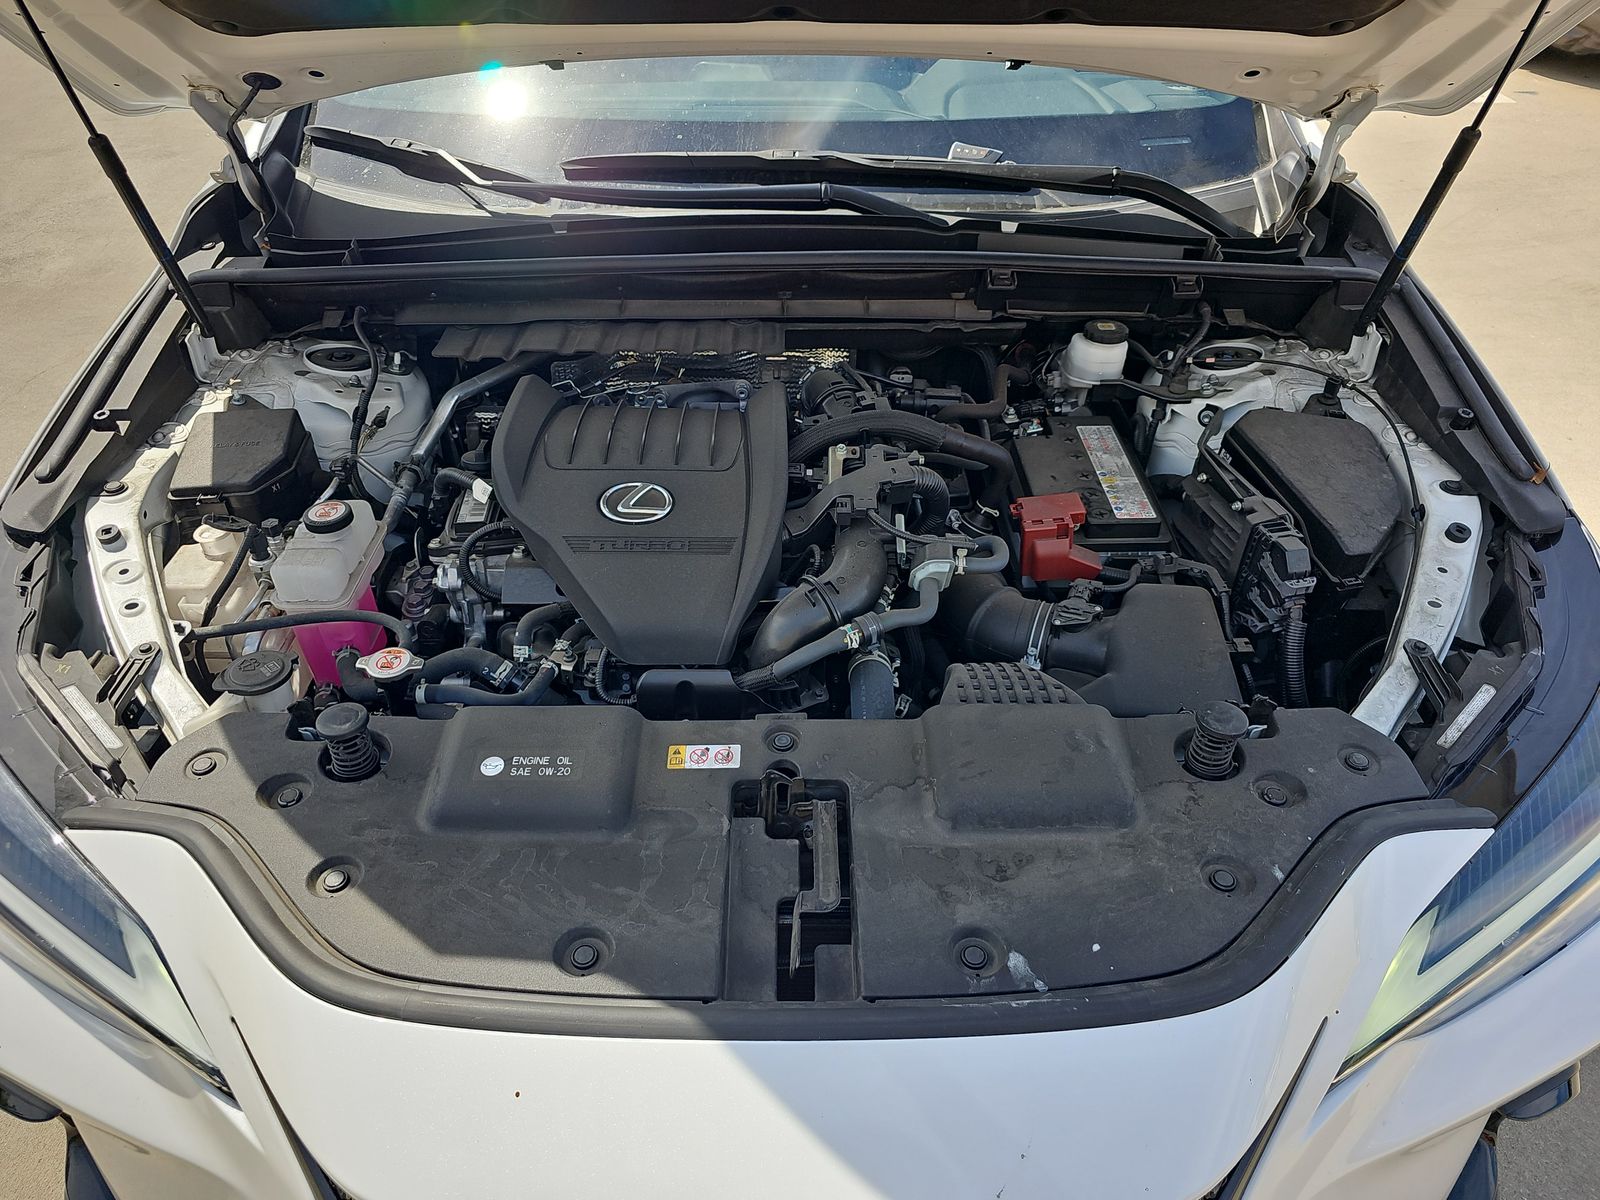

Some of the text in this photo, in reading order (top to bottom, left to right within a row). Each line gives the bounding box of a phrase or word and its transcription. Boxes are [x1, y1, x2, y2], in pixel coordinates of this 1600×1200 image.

[593, 539, 687, 551] TURBO
[512, 756, 573, 765] ENGINE OIL
[510, 767, 532, 776] SAE
